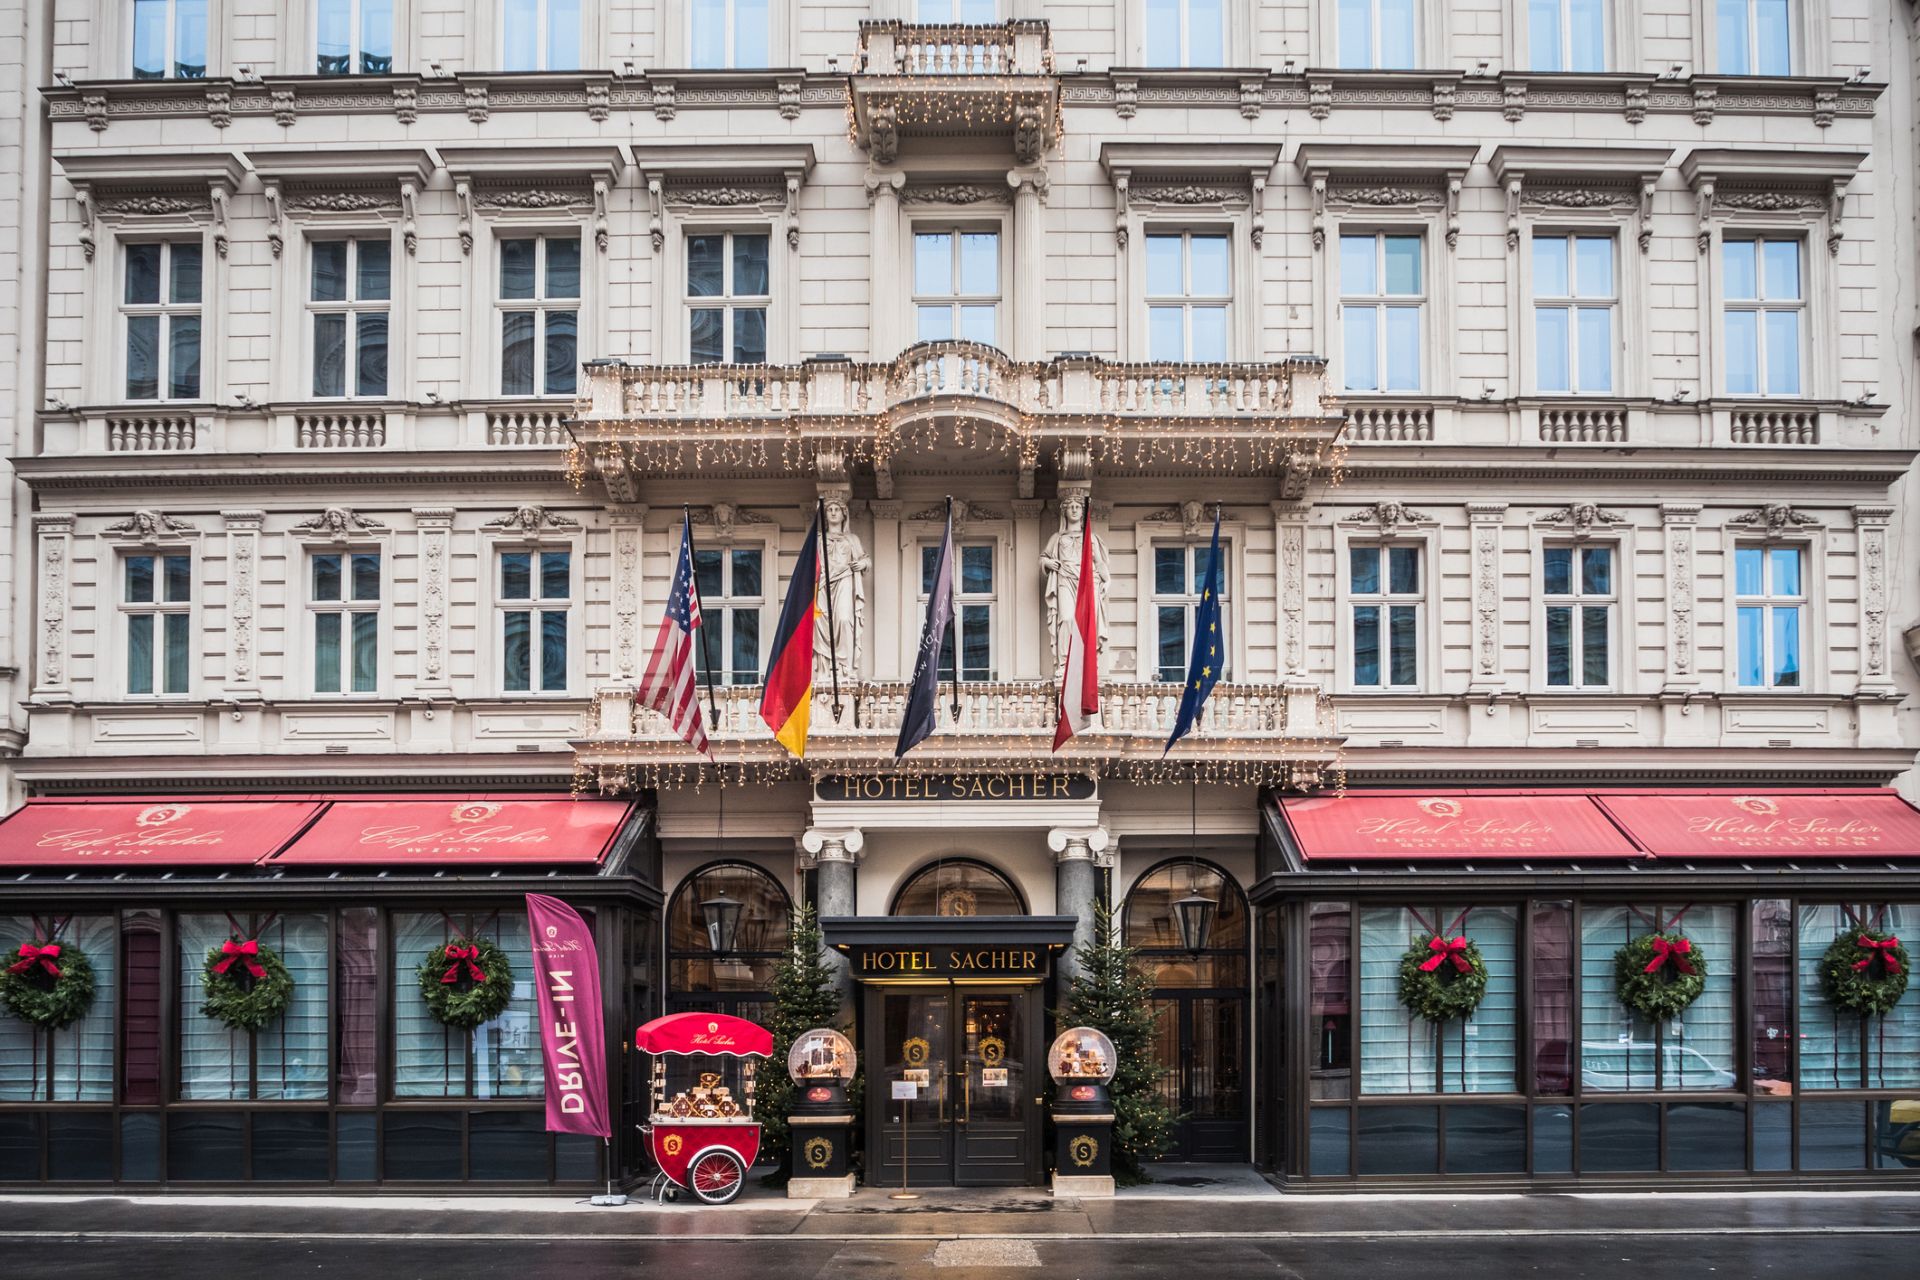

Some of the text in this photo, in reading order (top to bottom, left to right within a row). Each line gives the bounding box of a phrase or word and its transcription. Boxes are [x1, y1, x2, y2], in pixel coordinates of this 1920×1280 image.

[844, 777, 1071, 798] HOTEL SACHER
[1356, 818, 1553, 835] Hotel Sacher
[1688, 817, 1882, 834] Hotel Sacher
[115, 828, 224, 846] Sacher
[441, 826, 550, 844] Sacher
[954, 901, 965, 917] S
[862, 951, 1036, 970] HOTEL SACHER
[912, 1047, 920, 1059] S
[987, 1047, 996, 1059] S
[670, 1141, 677, 1150] S
[1080, 1146, 1088, 1158] S
[815, 1148, 823, 1160] S
